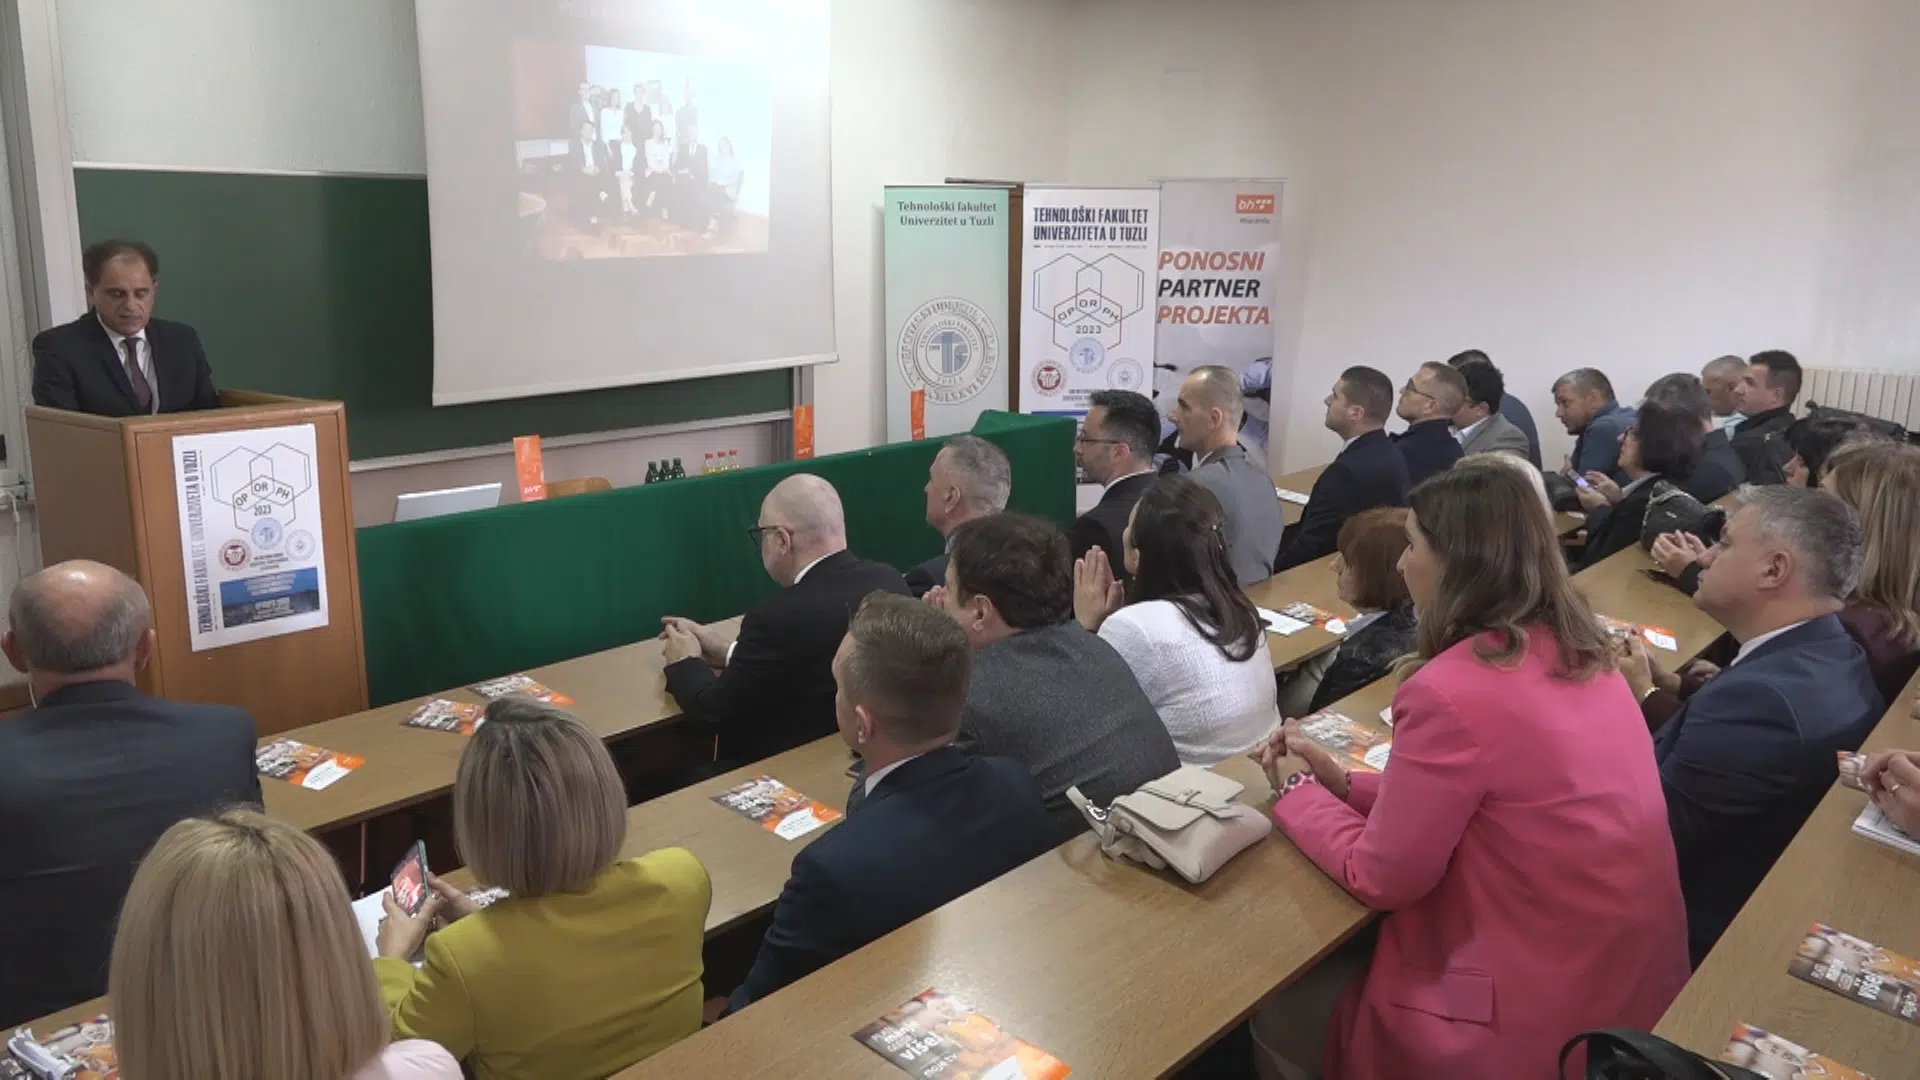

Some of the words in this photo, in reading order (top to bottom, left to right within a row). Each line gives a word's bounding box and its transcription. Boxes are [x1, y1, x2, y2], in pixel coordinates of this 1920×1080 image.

[897, 201, 955, 212] Tehnološki
[957, 201, 996, 212] fakultet
[1034, 205, 1095, 223] TEHNOLOŠKI
[1098, 209, 1148, 223] FAKULTET
[900, 216, 957, 226] Univerzitet
[961, 218, 966, 226] u
[969, 216, 994, 226] Tuzli
[1033, 225, 1106, 240] UNIVERZITETA
[1110, 226, 1116, 241] U
[1120, 227, 1148, 241] TUZLI
[1158, 251, 1266, 271] PONOSNI
[1157, 279, 1261, 298] PARTNER
[1079, 299, 1097, 308] OR
[1102, 307, 1119, 320] PH
[1156, 305, 1270, 324] PROJEKTA
[1075, 325, 1102, 334] 2023
[182, 450, 198, 474] TUZLI
[236, 493, 249, 507] OP
[254, 482, 268, 492] OR
[276, 487, 290, 499] PH
[253, 505, 272, 516] 2023
